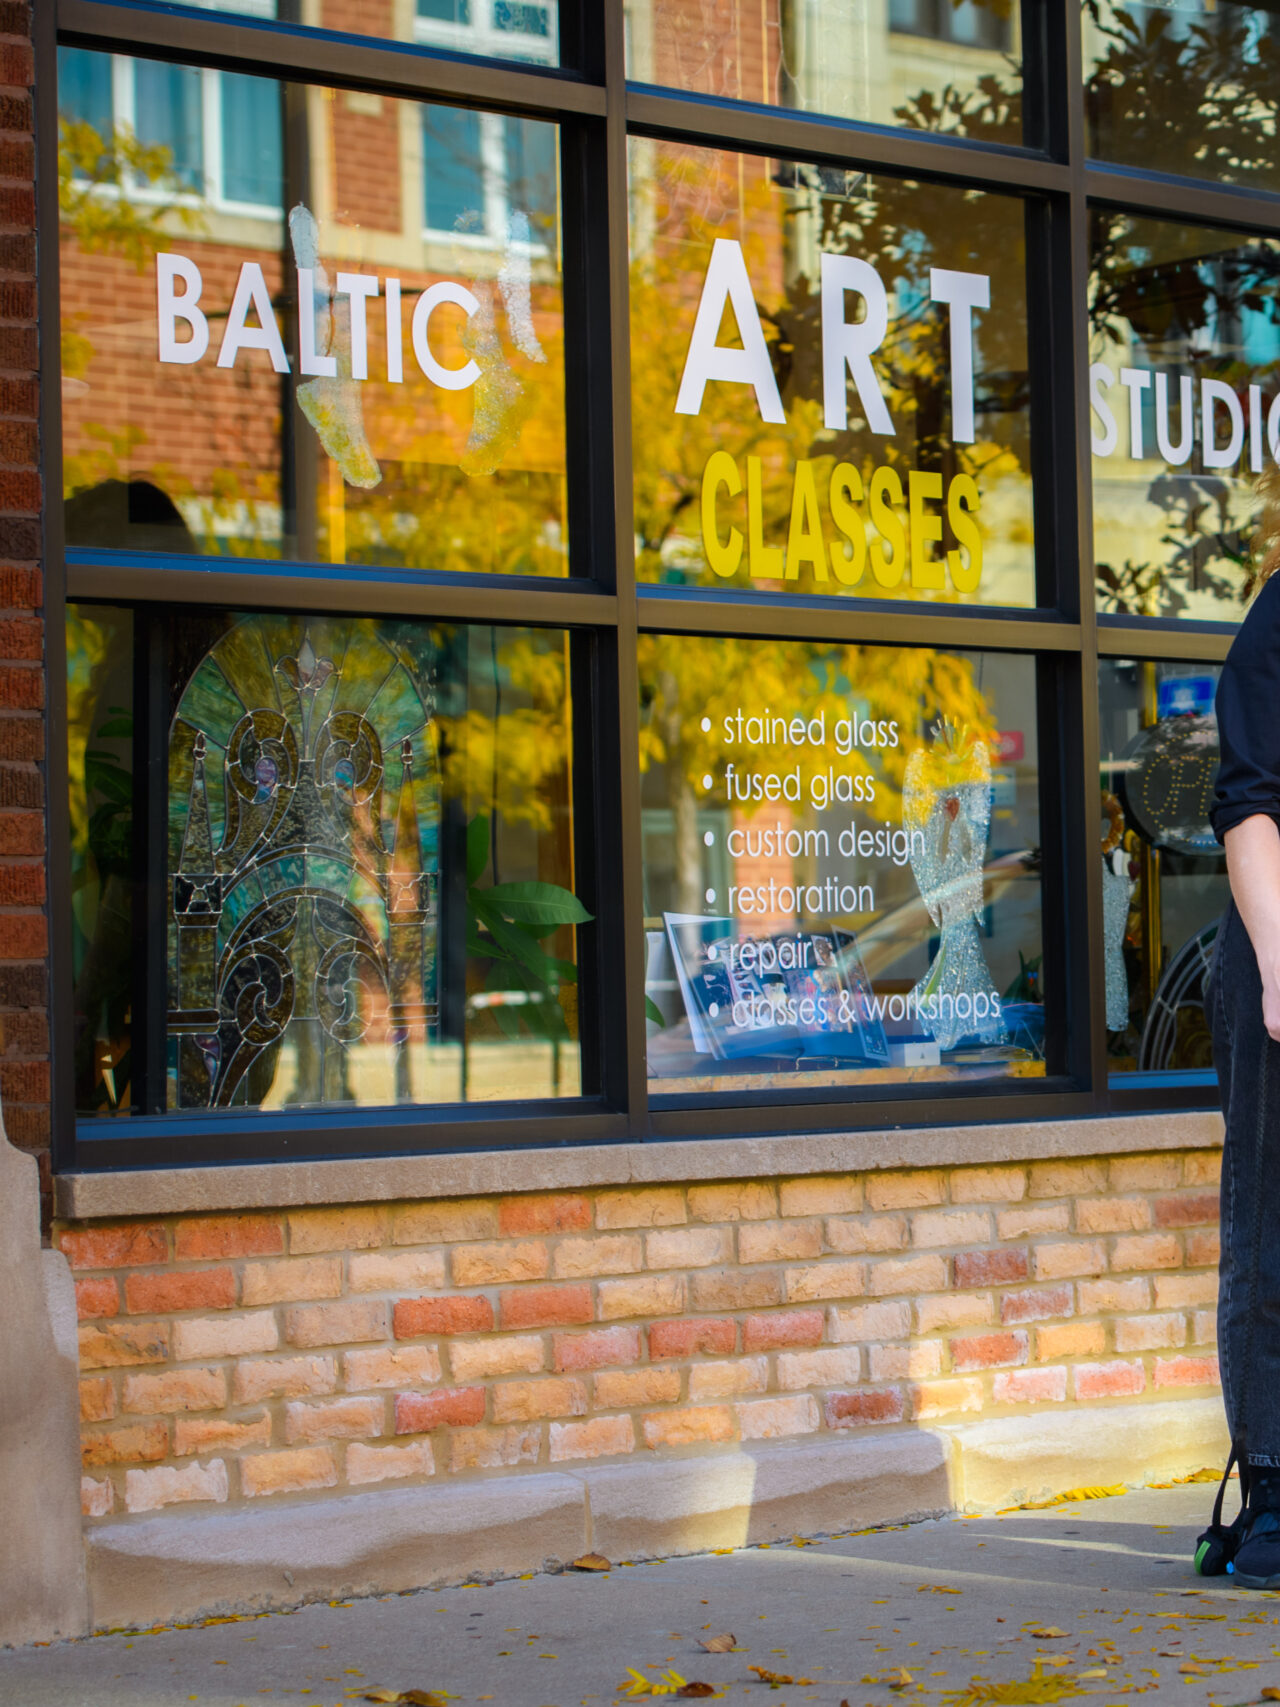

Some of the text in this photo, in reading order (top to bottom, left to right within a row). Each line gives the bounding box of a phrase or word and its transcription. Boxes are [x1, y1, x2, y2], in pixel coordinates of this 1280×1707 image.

[157, 252, 481, 390] BALTIC
[675, 238, 990, 443] ART
[701, 451, 982, 593] CLASSES
[723, 708, 899, 755] stained glass
[725, 764, 875, 811] fused glass
[727, 821, 925, 866] custom design
[728, 876, 874, 914] restoration
[729, 933, 812, 978] repair
[732, 985, 1000, 1027] classes & workshops
